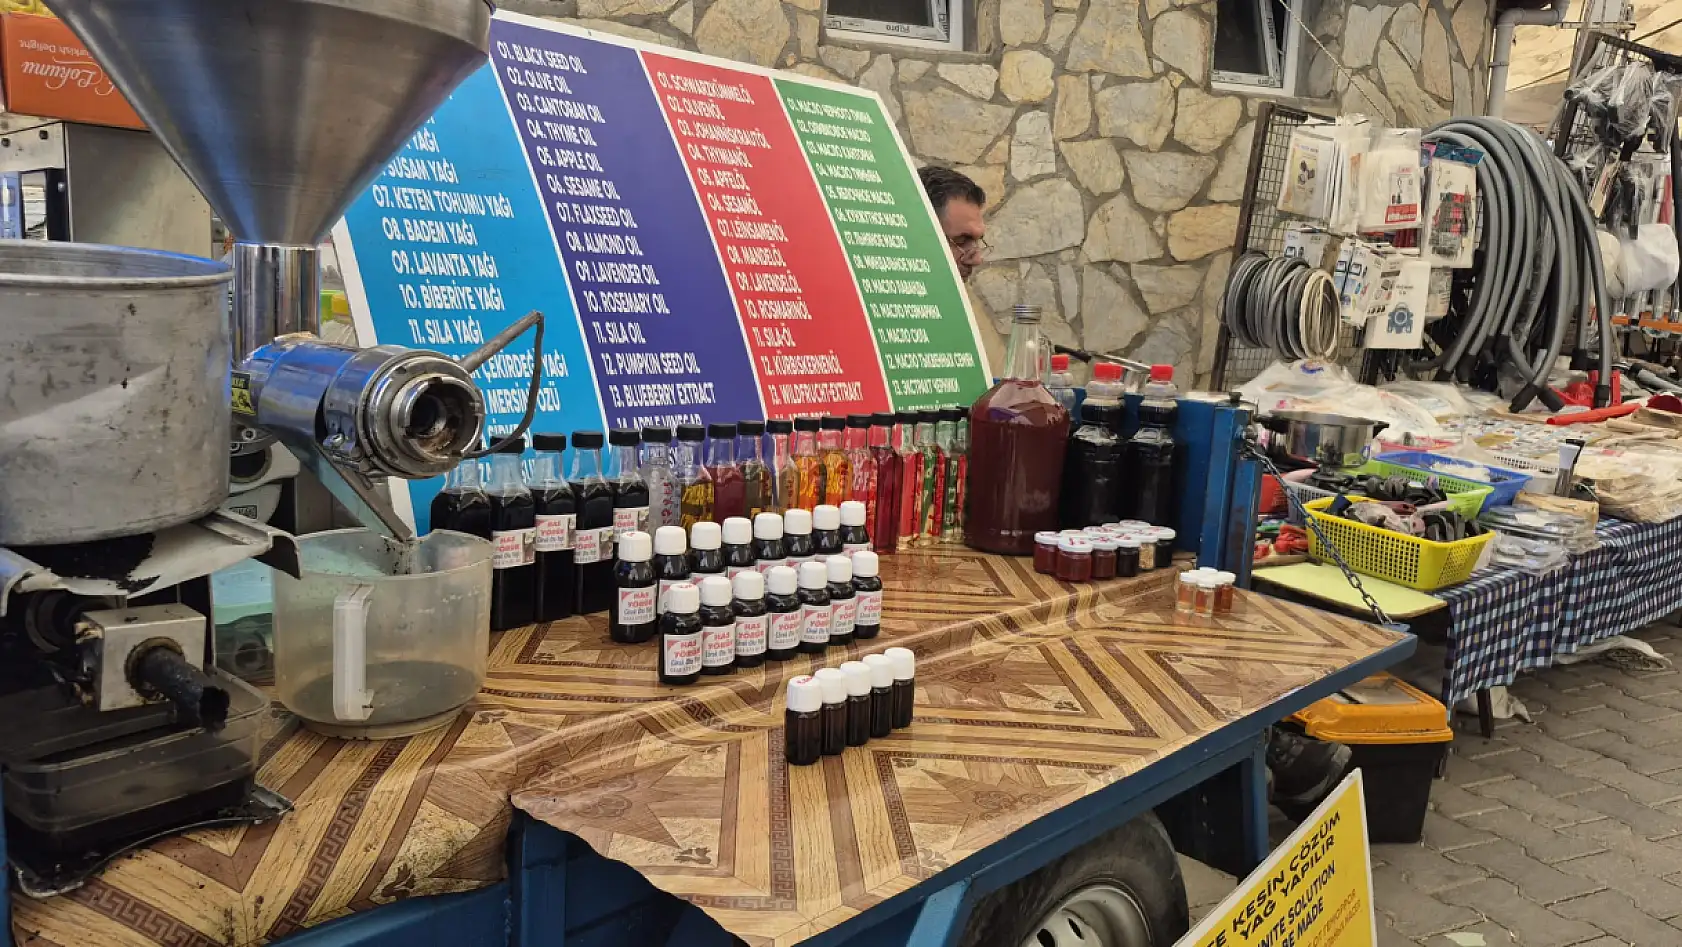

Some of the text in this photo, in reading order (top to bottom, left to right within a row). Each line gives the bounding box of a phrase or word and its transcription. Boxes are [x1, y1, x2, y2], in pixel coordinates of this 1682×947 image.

[19, 40, 55, 53] Delight
[497, 41, 587, 74] 01. BLACK SEED OIL
[507, 66, 572, 94] 02. OLIVE OIL
[657, 72, 673, 88] 01.
[517, 92, 605, 123] 03. CANTORAN OIL
[667, 94, 725, 120] 02. OLIVENÖL
[787, 98, 800, 112] 01.
[526, 119, 597, 146] 04. THYME OIL
[678, 118, 694, 136] 03.
[797, 119, 809, 133] 02.
[688, 143, 705, 160] 04.
[806, 140, 819, 154] 03.
[427, 157, 459, 184] YAĞI
[537, 146, 604, 172] 05. APPLE OIL
[816, 163, 829, 176] 04.
[547, 174, 620, 200] 06. SESAME OIL
[697, 168, 750, 190] 05. APFELÖL
[372, 185, 514, 218] 07. KETEN TOHUMU YAĞI
[707, 192, 762, 215] 06. SESAMÖL
[826, 185, 838, 199] 05.
[556, 202, 638, 228] 07. FLAXSEED OIL
[834, 208, 848, 222] 06.
[382, 217, 478, 246] 08. BADEM YAĞI
[717, 218, 733, 237] 07.
[566, 231, 643, 256] 08. ALMOND OIL
[727, 244, 786, 266] 08. MANDELÖL
[391, 250, 499, 278] 09. LAVANTA YAĞI
[576, 260, 660, 284] 09. LAVENDER OIL
[736, 270, 802, 293] 09. LAVENDELÖL
[399, 279, 506, 311] 10. BİBERİYE YAĞI
[583, 291, 670, 314] 10. ROSEMARY OIL
[744, 297, 812, 319] 10. ROSMARINÖL
[870, 304, 881, 318] 10.
[408, 316, 484, 345] 11. SILA YAĞI
[592, 322, 646, 344] 11. SILA OIL
[752, 327, 765, 347] 11.
[878, 328, 888, 343] 11.
[541, 349, 569, 378] YAĞI
[601, 352, 700, 374] 12. PUMPKIN SEED OIL
[761, 356, 775, 376] 12.
[885, 354, 896, 369] 12.
[609, 382, 716, 407] 13. BLUEBERRY EXTRACT
[768, 384, 782, 404] 13.
[892, 380, 903, 395] 13.
[1240, 900, 1276, 940] YAĞ
[1280, 834, 1335, 897] YAPILIR
[1287, 860, 1336, 924] SOLUTION
[1232, 870, 1285, 932] KESİN
[1297, 896, 1324, 940] MADE
